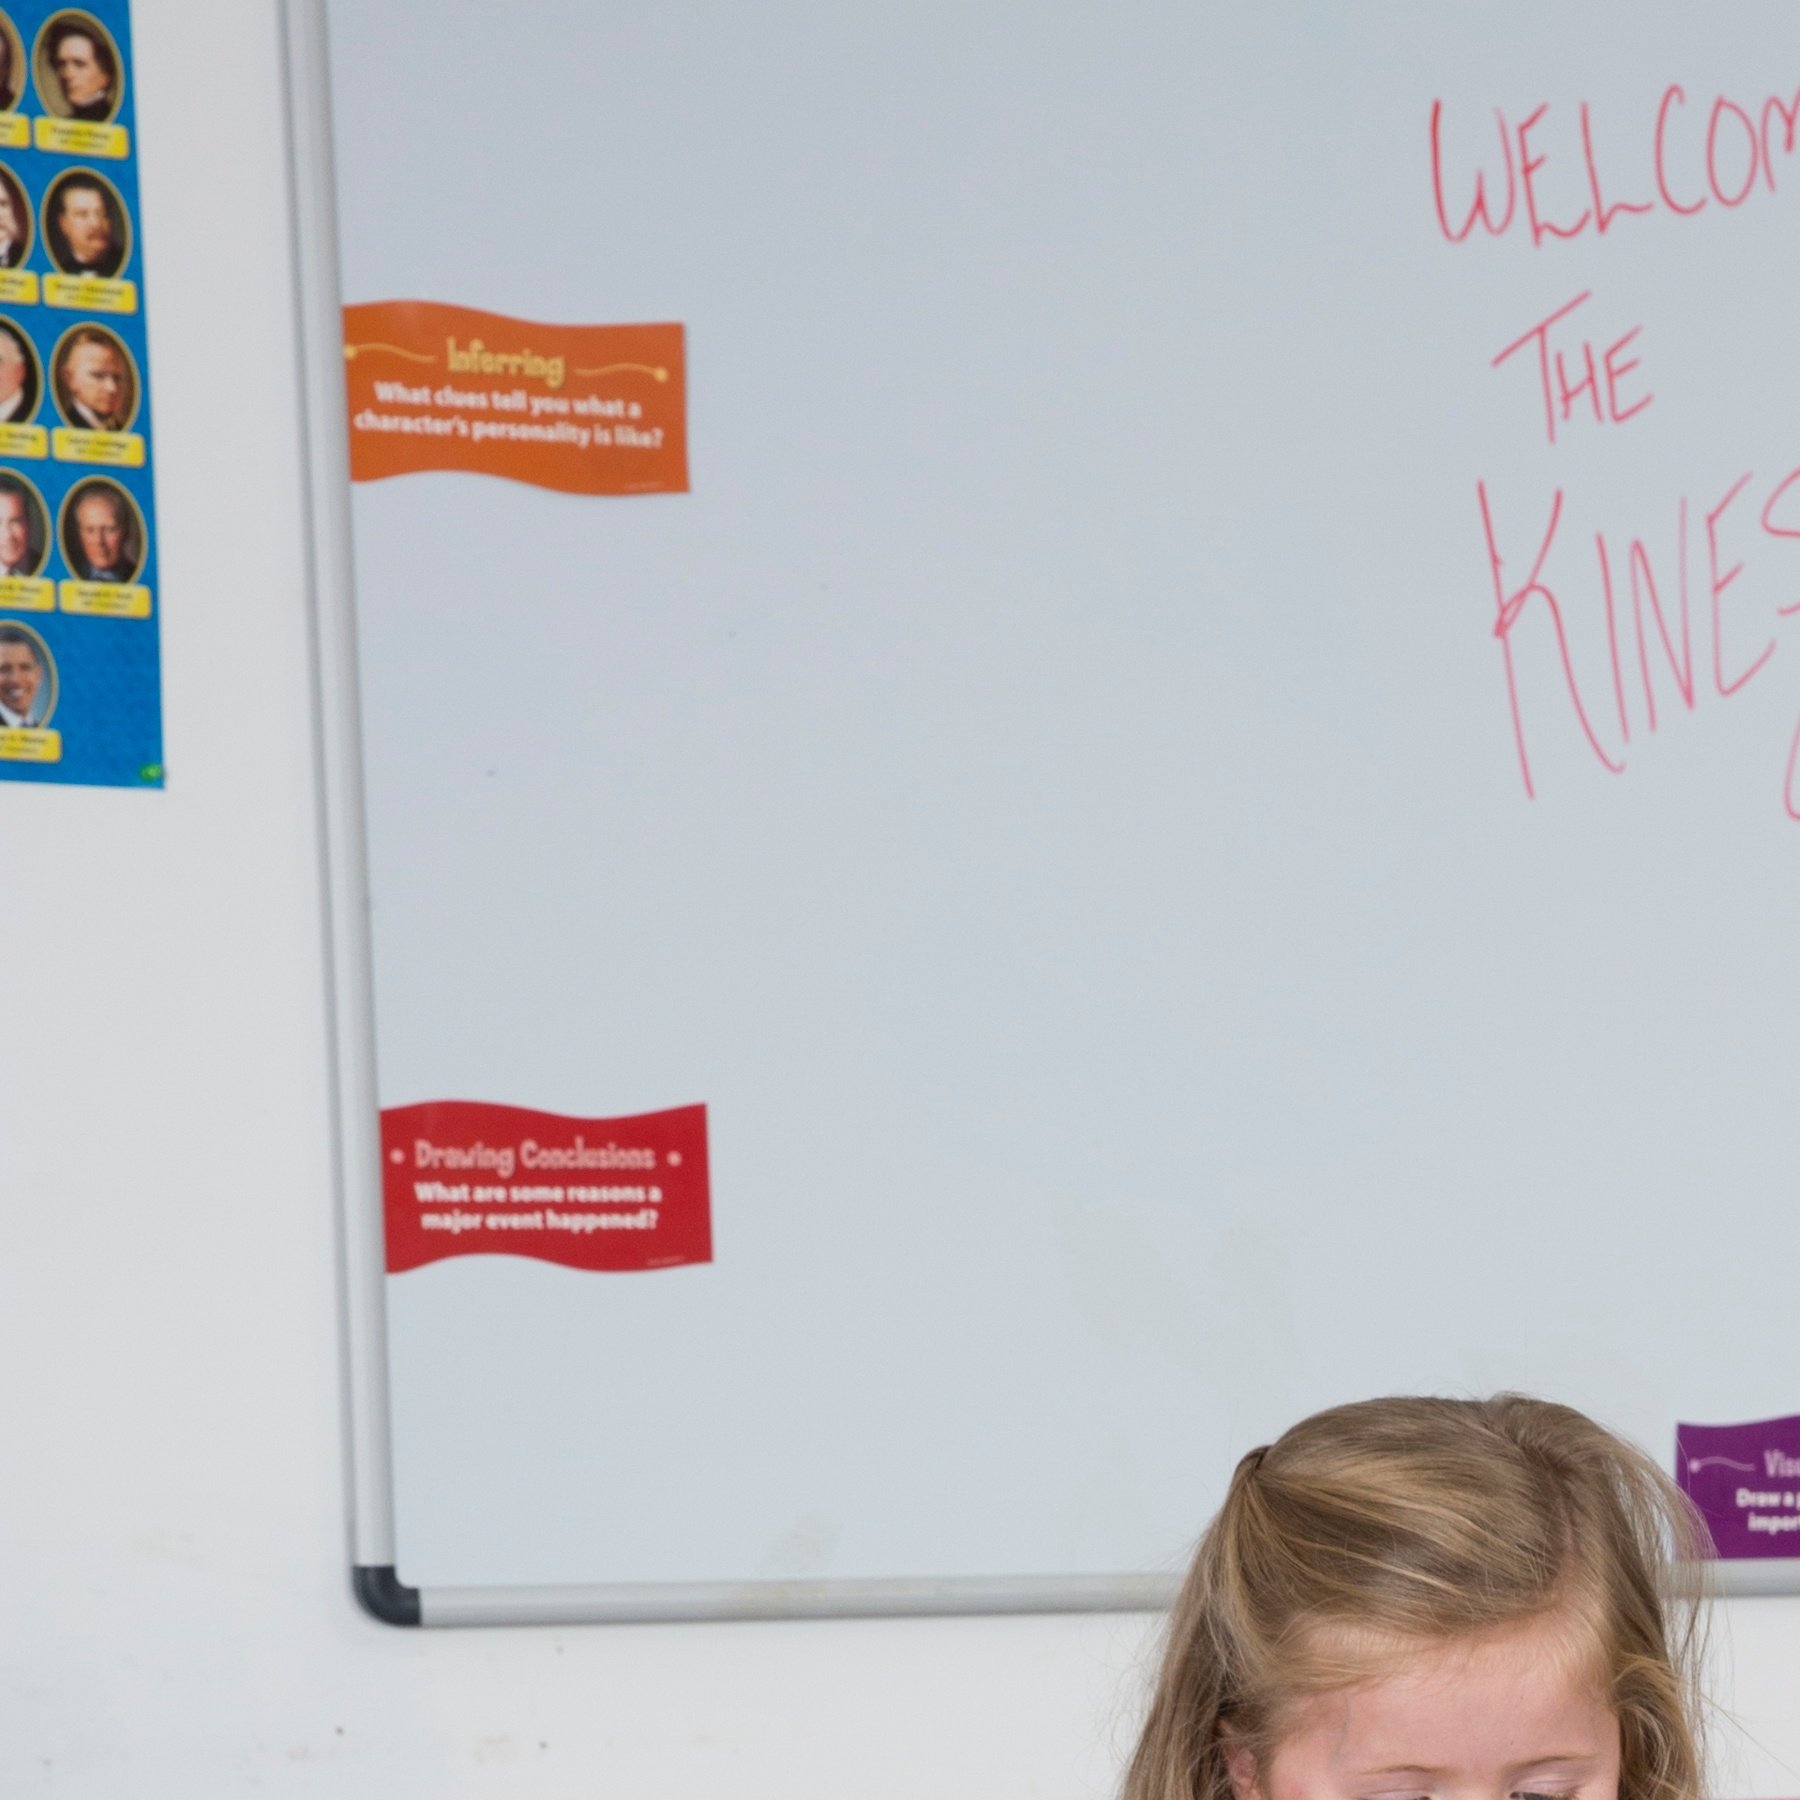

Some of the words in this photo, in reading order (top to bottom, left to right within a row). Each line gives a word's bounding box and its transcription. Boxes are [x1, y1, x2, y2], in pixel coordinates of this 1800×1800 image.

[447, 336, 565, 389] Inferring
[1492, 290, 1654, 443] THE
[373, 380, 431, 406] What
[433, 384, 489, 410] clues
[490, 389, 528, 413] tell
[530, 395, 569, 419] you
[572, 394, 625, 418] what
[627, 400, 642, 419] a
[354, 408, 469, 436] character's
[471, 418, 590, 449] personality
[593, 425, 612, 446] is
[614, 424, 665, 449] like?
[414, 1138, 516, 1179] Drawing
[519, 1134, 657, 1170] Conclusions
[413, 1180, 470, 1204] What
[471, 1185, 508, 1204] are
[509, 1185, 565, 1204] some
[566, 1185, 646, 1204] reasons
[648, 1185, 662, 1204] a
[420, 1207, 484, 1236] major
[485, 1210, 544, 1231] event
[546, 1207, 659, 1235] happened?
[1735, 1487, 1781, 1508] Draw
[1783, 1490, 1795, 1508] a
